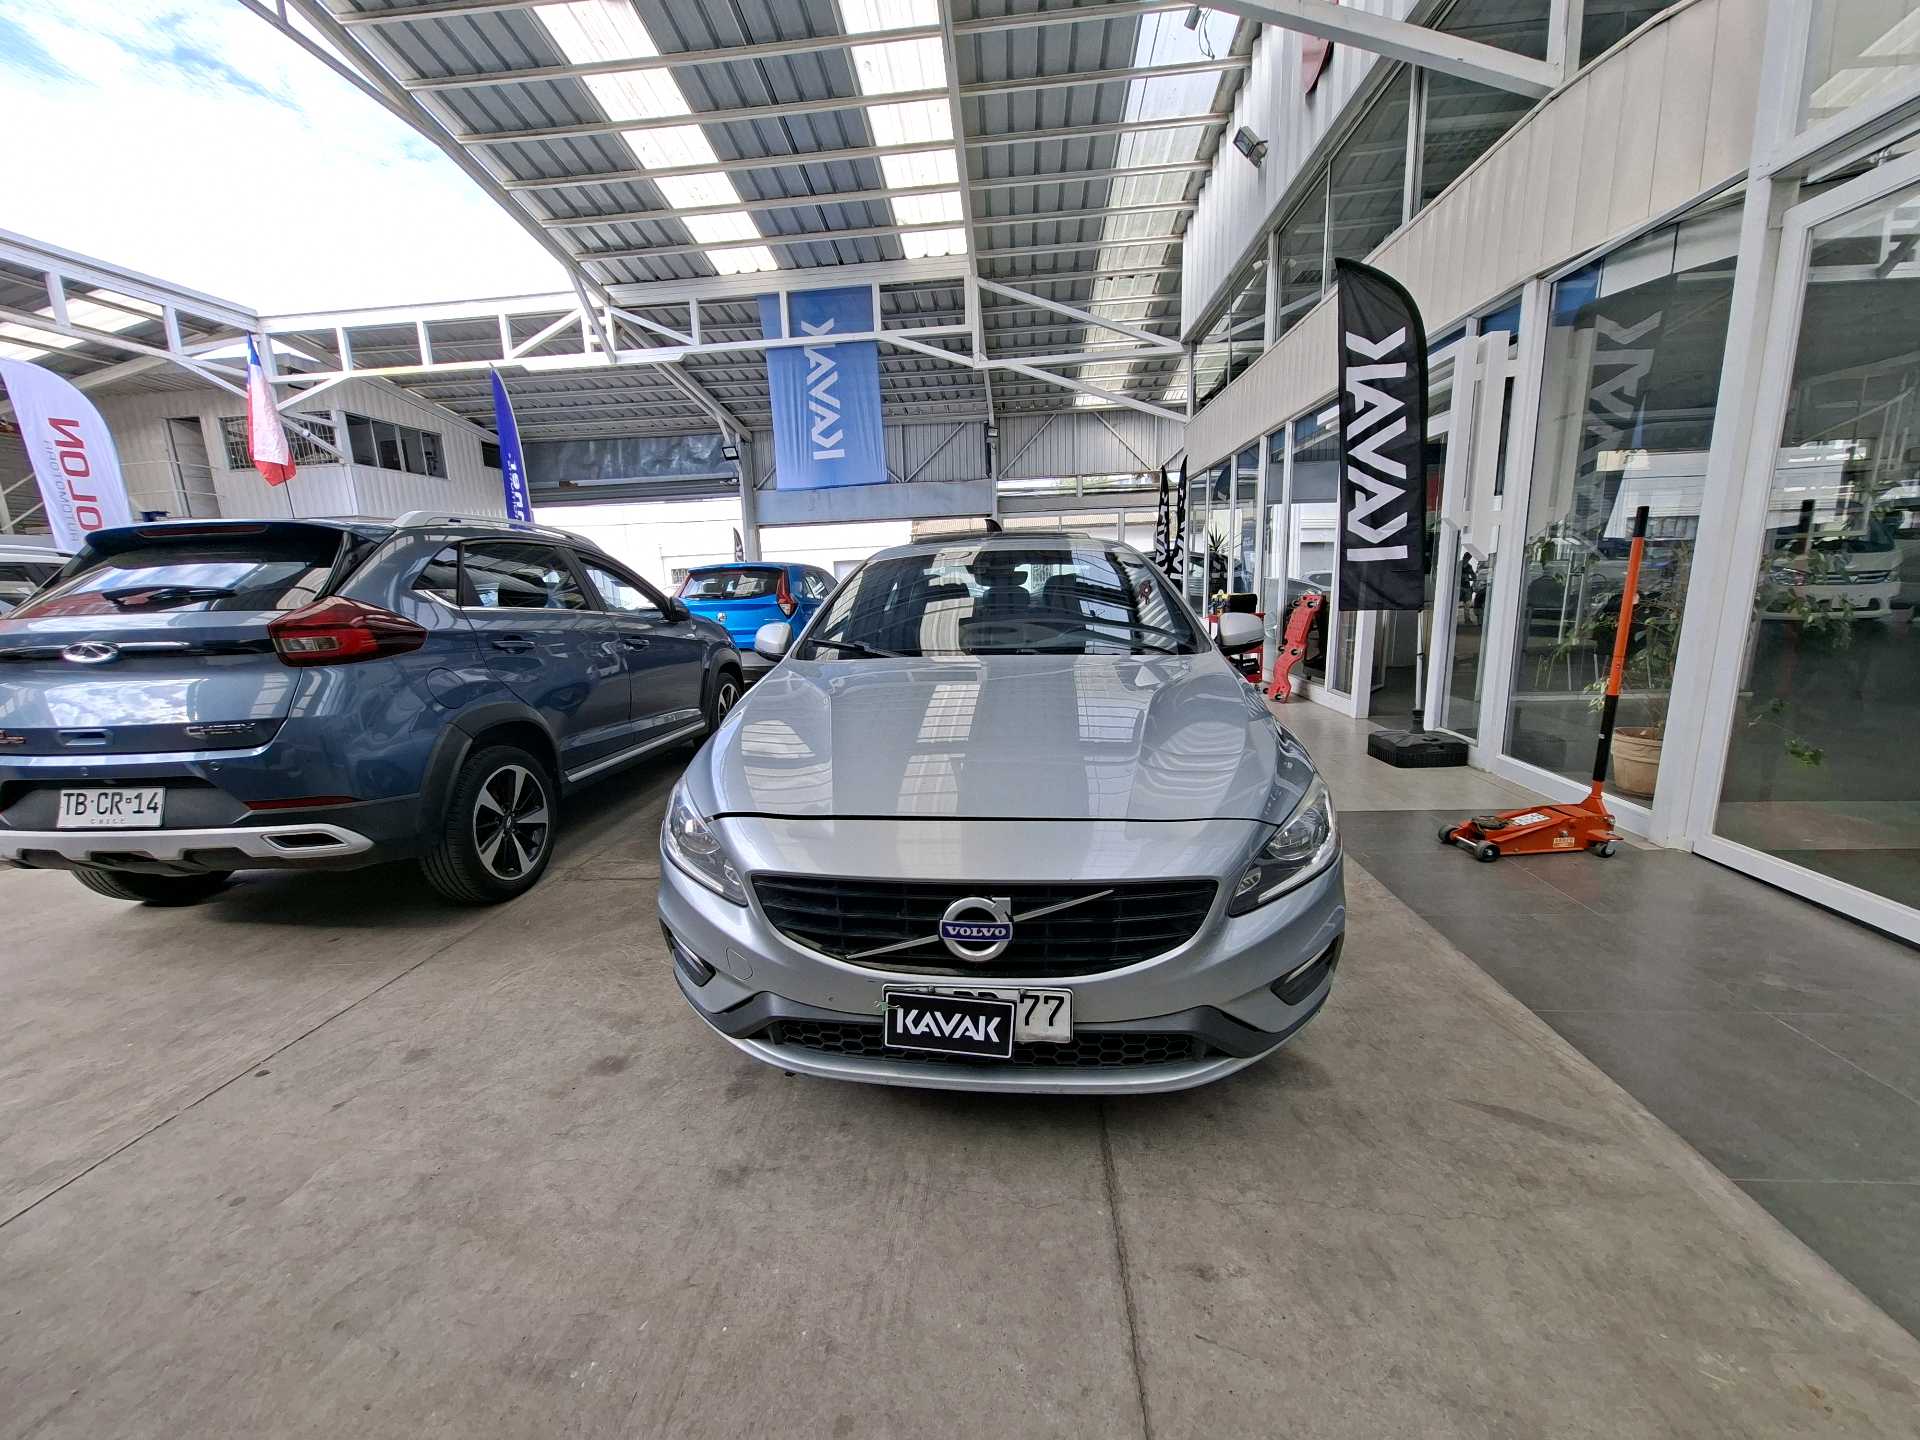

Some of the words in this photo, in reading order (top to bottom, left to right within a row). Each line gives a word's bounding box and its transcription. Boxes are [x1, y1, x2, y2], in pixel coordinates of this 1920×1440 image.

[945, 925, 1007, 937] VOLVO
[896, 1007, 1002, 1043] KAVAK
[1019, 994, 1065, 1027] 77
